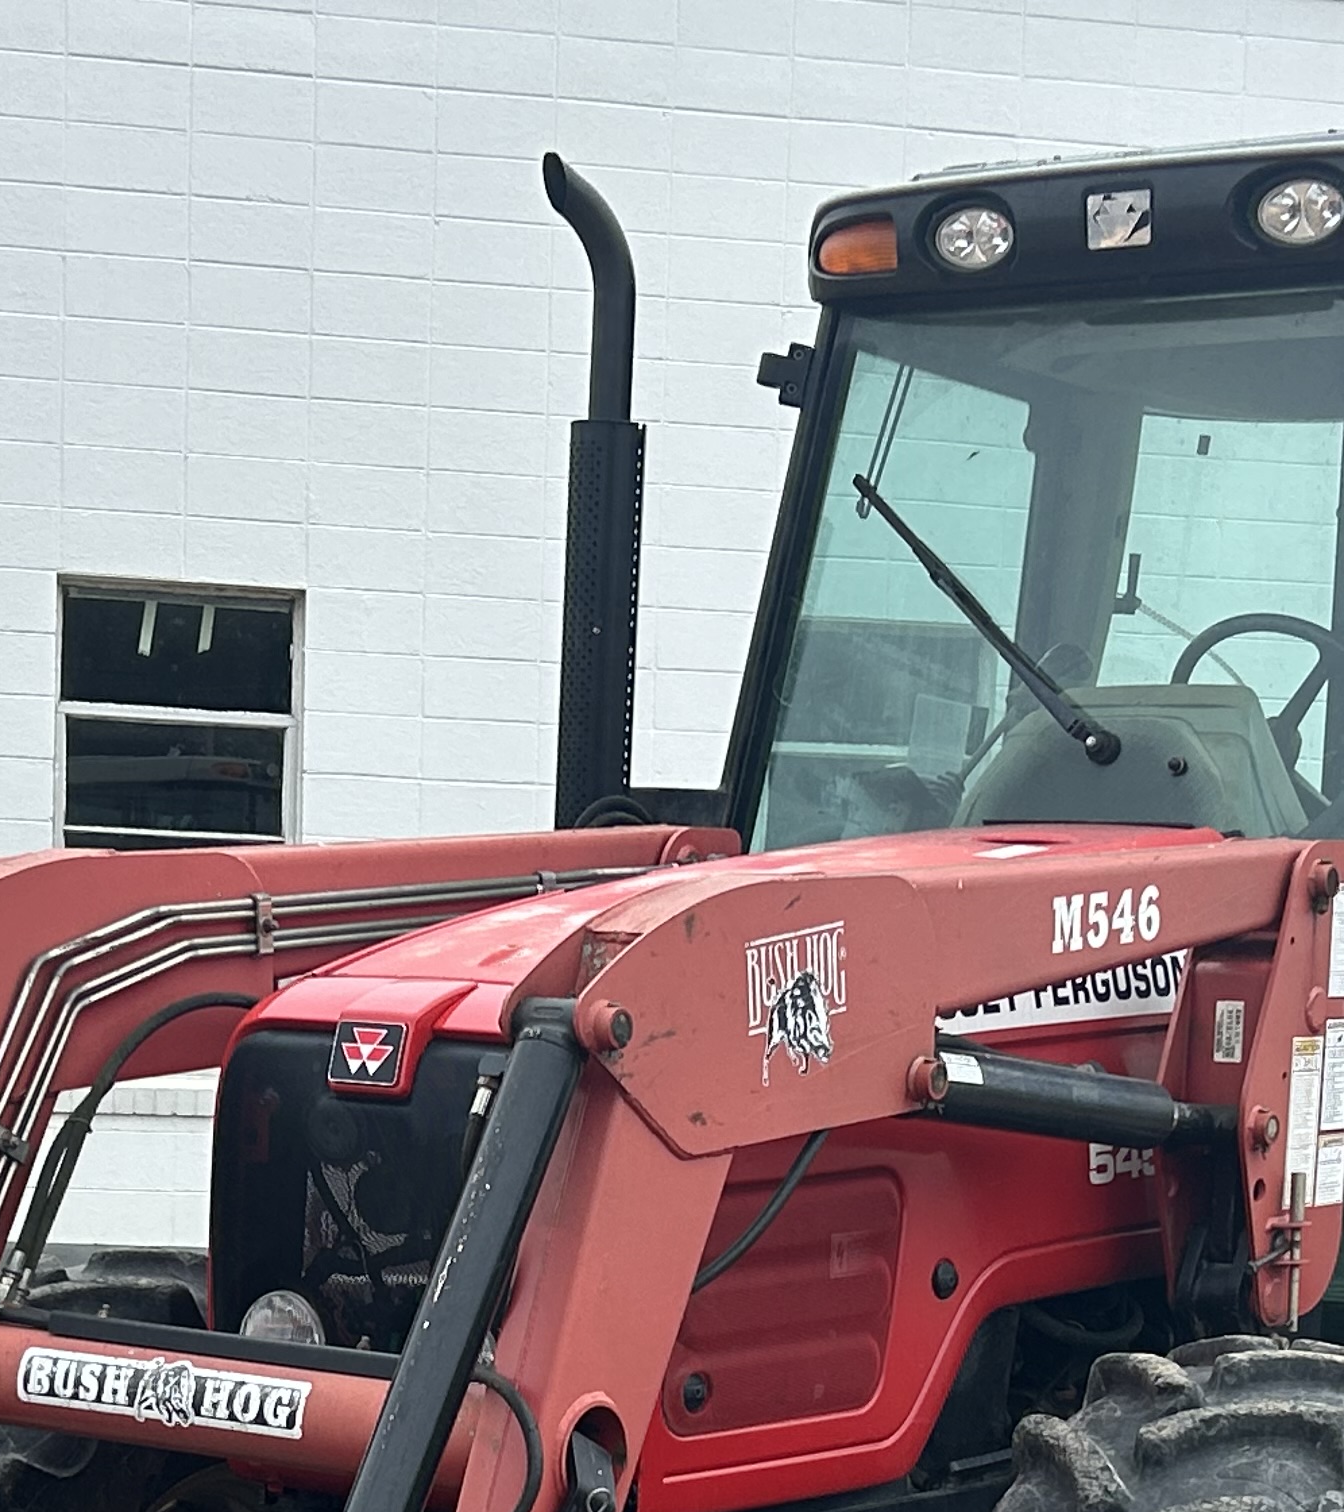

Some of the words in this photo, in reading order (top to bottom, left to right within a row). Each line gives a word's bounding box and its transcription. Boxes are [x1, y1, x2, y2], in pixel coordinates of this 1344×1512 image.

[1052, 885, 1160, 954] M546
[26, 1356, 137, 1406] BUSH
[200, 1379, 303, 1429] HOG
